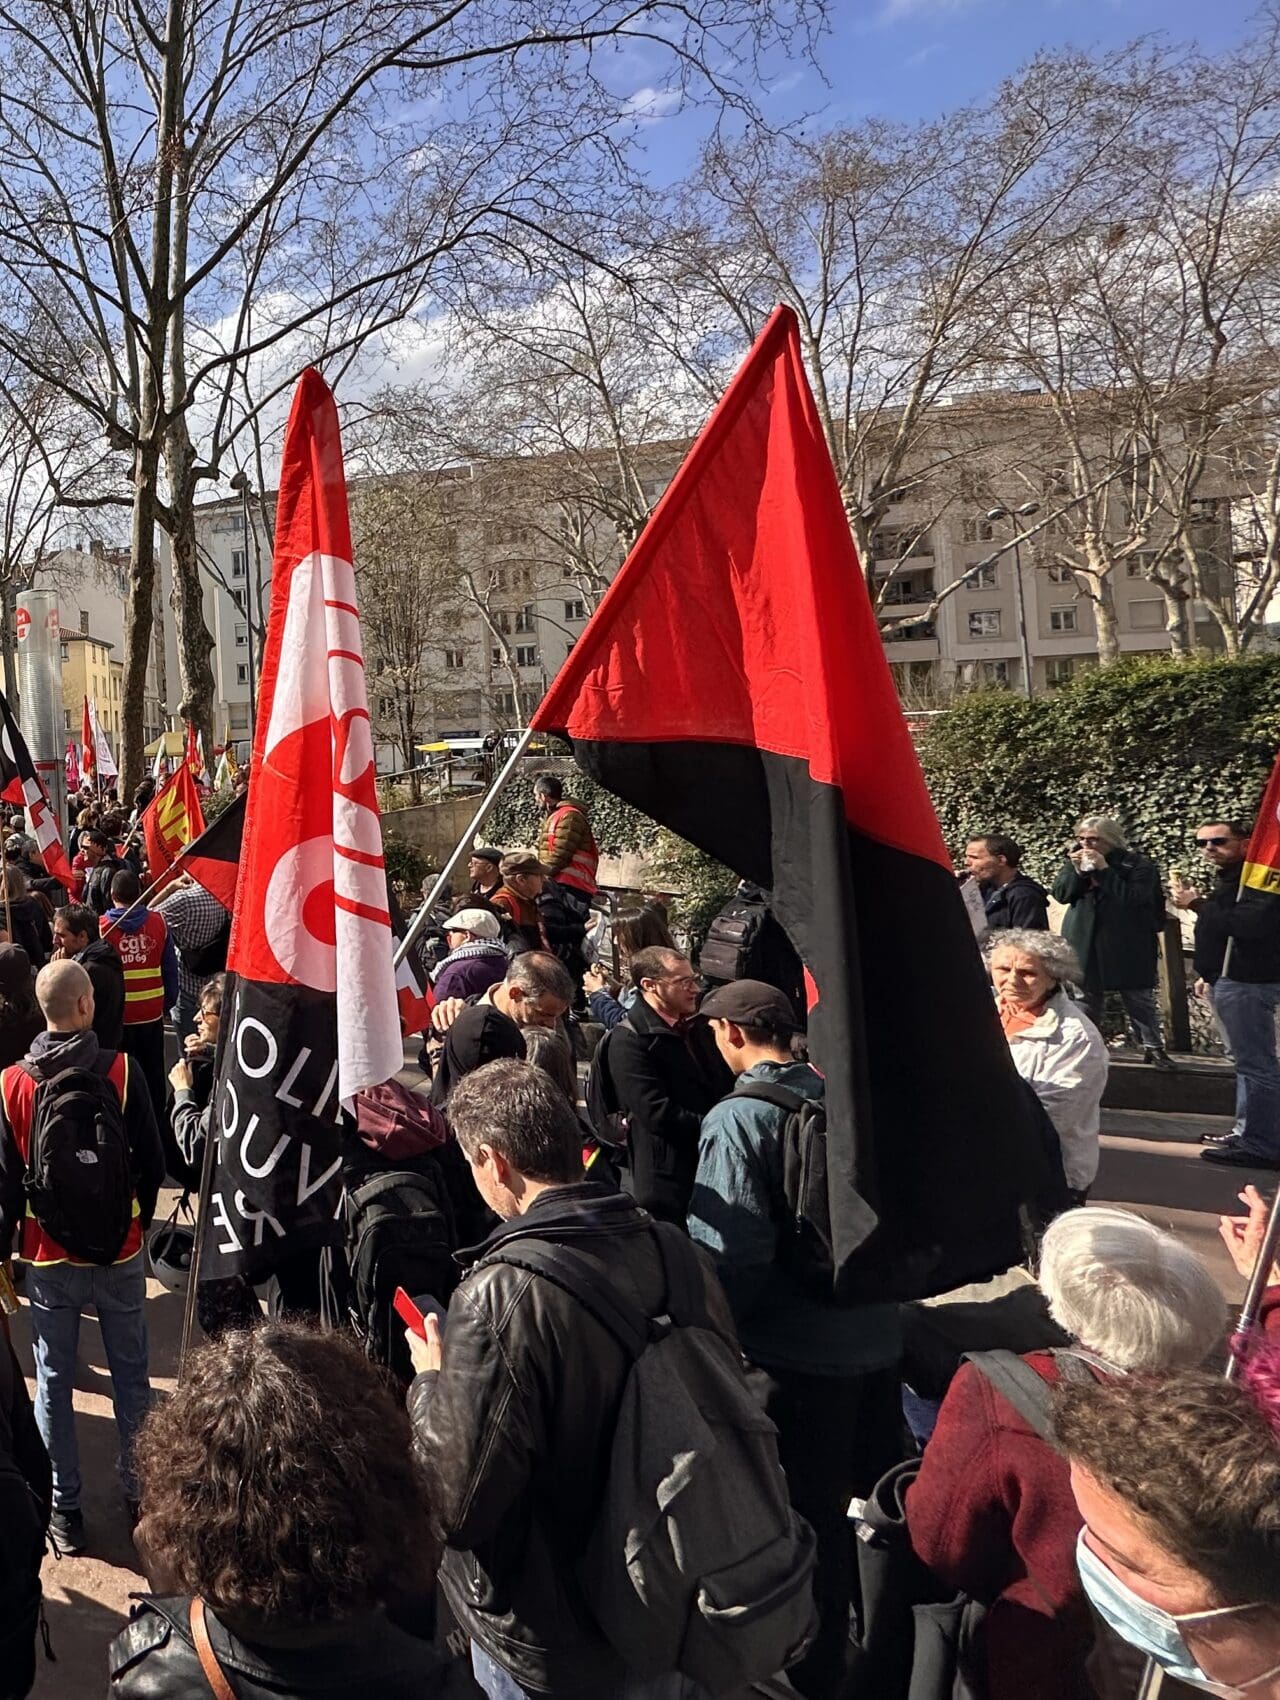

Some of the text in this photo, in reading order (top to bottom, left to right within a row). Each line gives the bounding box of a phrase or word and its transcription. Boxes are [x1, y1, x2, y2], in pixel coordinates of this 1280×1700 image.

[119, 933, 147, 954] cgt
[121, 954, 147, 964] UD 69
